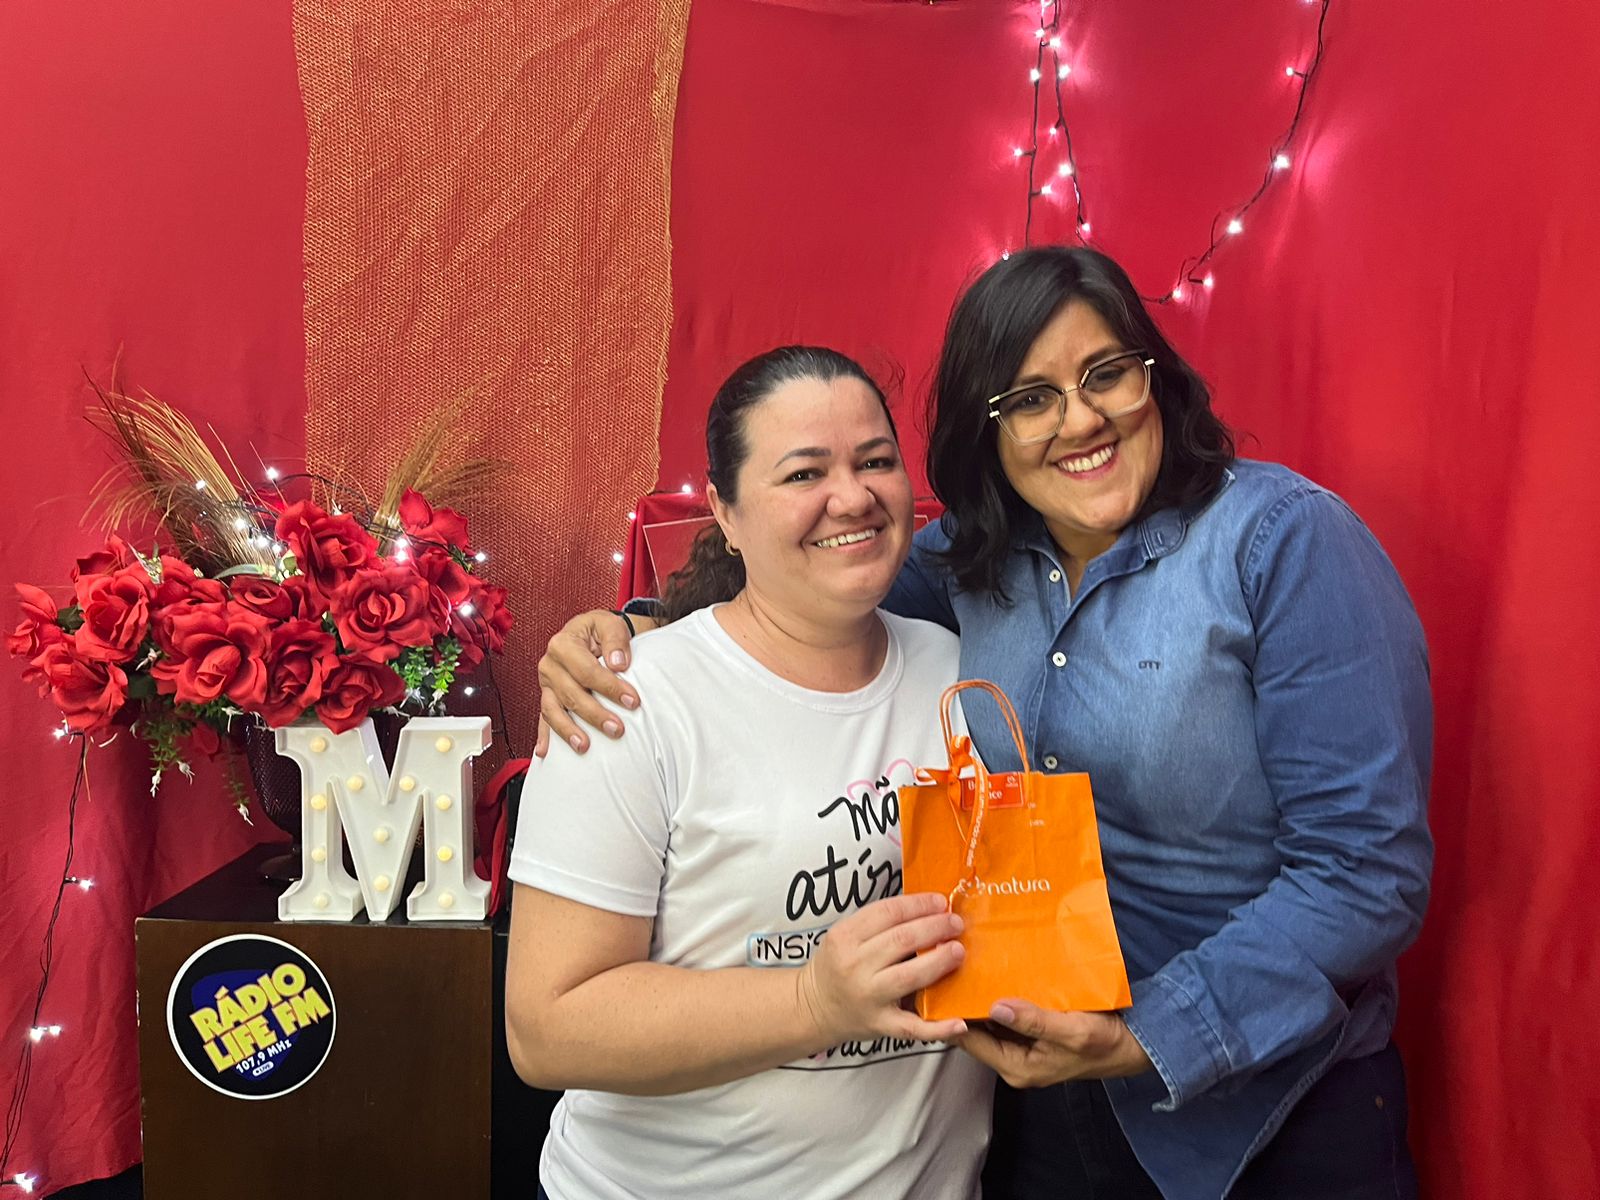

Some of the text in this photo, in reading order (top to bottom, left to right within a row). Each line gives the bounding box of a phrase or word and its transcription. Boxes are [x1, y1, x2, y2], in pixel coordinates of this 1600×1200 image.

[987, 876, 1051, 896] natura
[189, 963, 307, 1043] RÁDIO
[203, 986, 331, 1073] LIFE FM
[236, 1039, 292, 1074] 107,9 MHz
